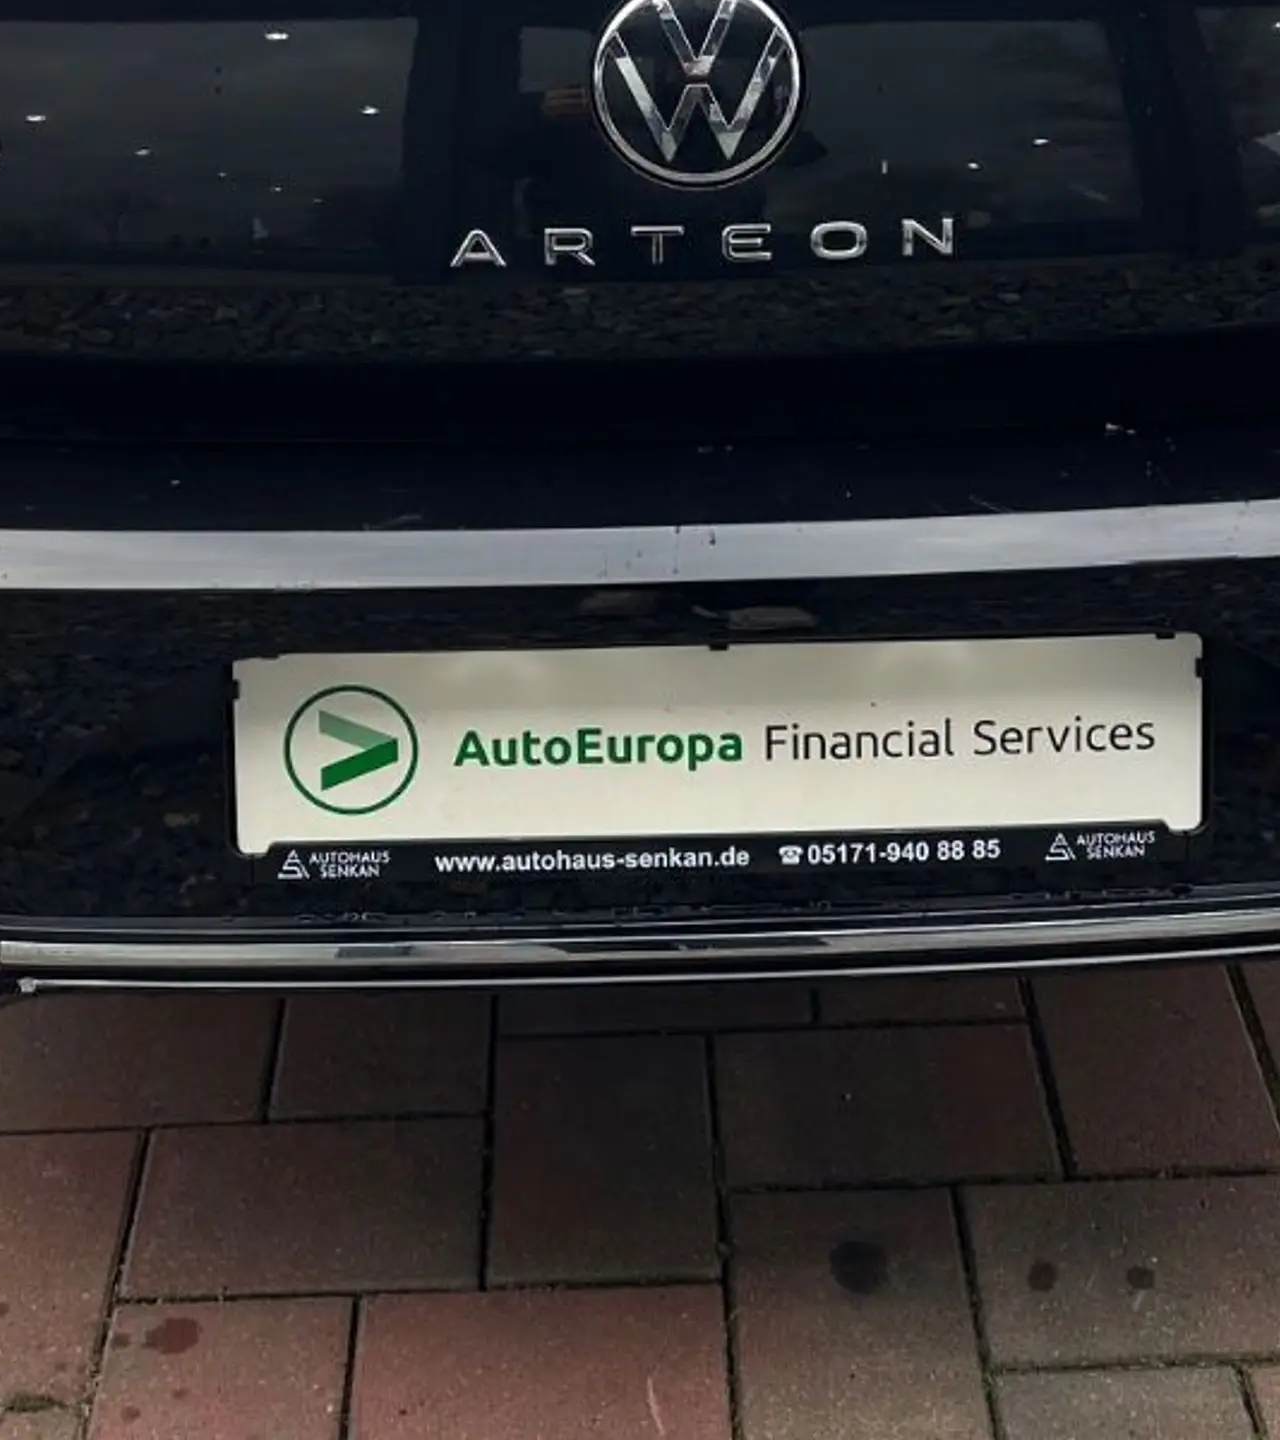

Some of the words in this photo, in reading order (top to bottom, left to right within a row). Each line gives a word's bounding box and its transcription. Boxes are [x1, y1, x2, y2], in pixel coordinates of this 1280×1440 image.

[450, 218, 954, 267] ARTEON
[454, 727, 743, 771] AutoEuropa
[764, 718, 953, 762] Financial
[971, 714, 1156, 757] Services
[1076, 830, 1156, 845] AUTOHAUS
[309, 849, 391, 865] AUTOHAUS
[434, 845, 750, 872] www.autohaus-senkan.de
[807, 842, 930, 864] 05171-940
[936, 840, 965, 861] 88
[971, 839, 1002, 859] 85
[1086, 844, 1145, 860] SENKAN
[320, 863, 380, 879] SENKAN
